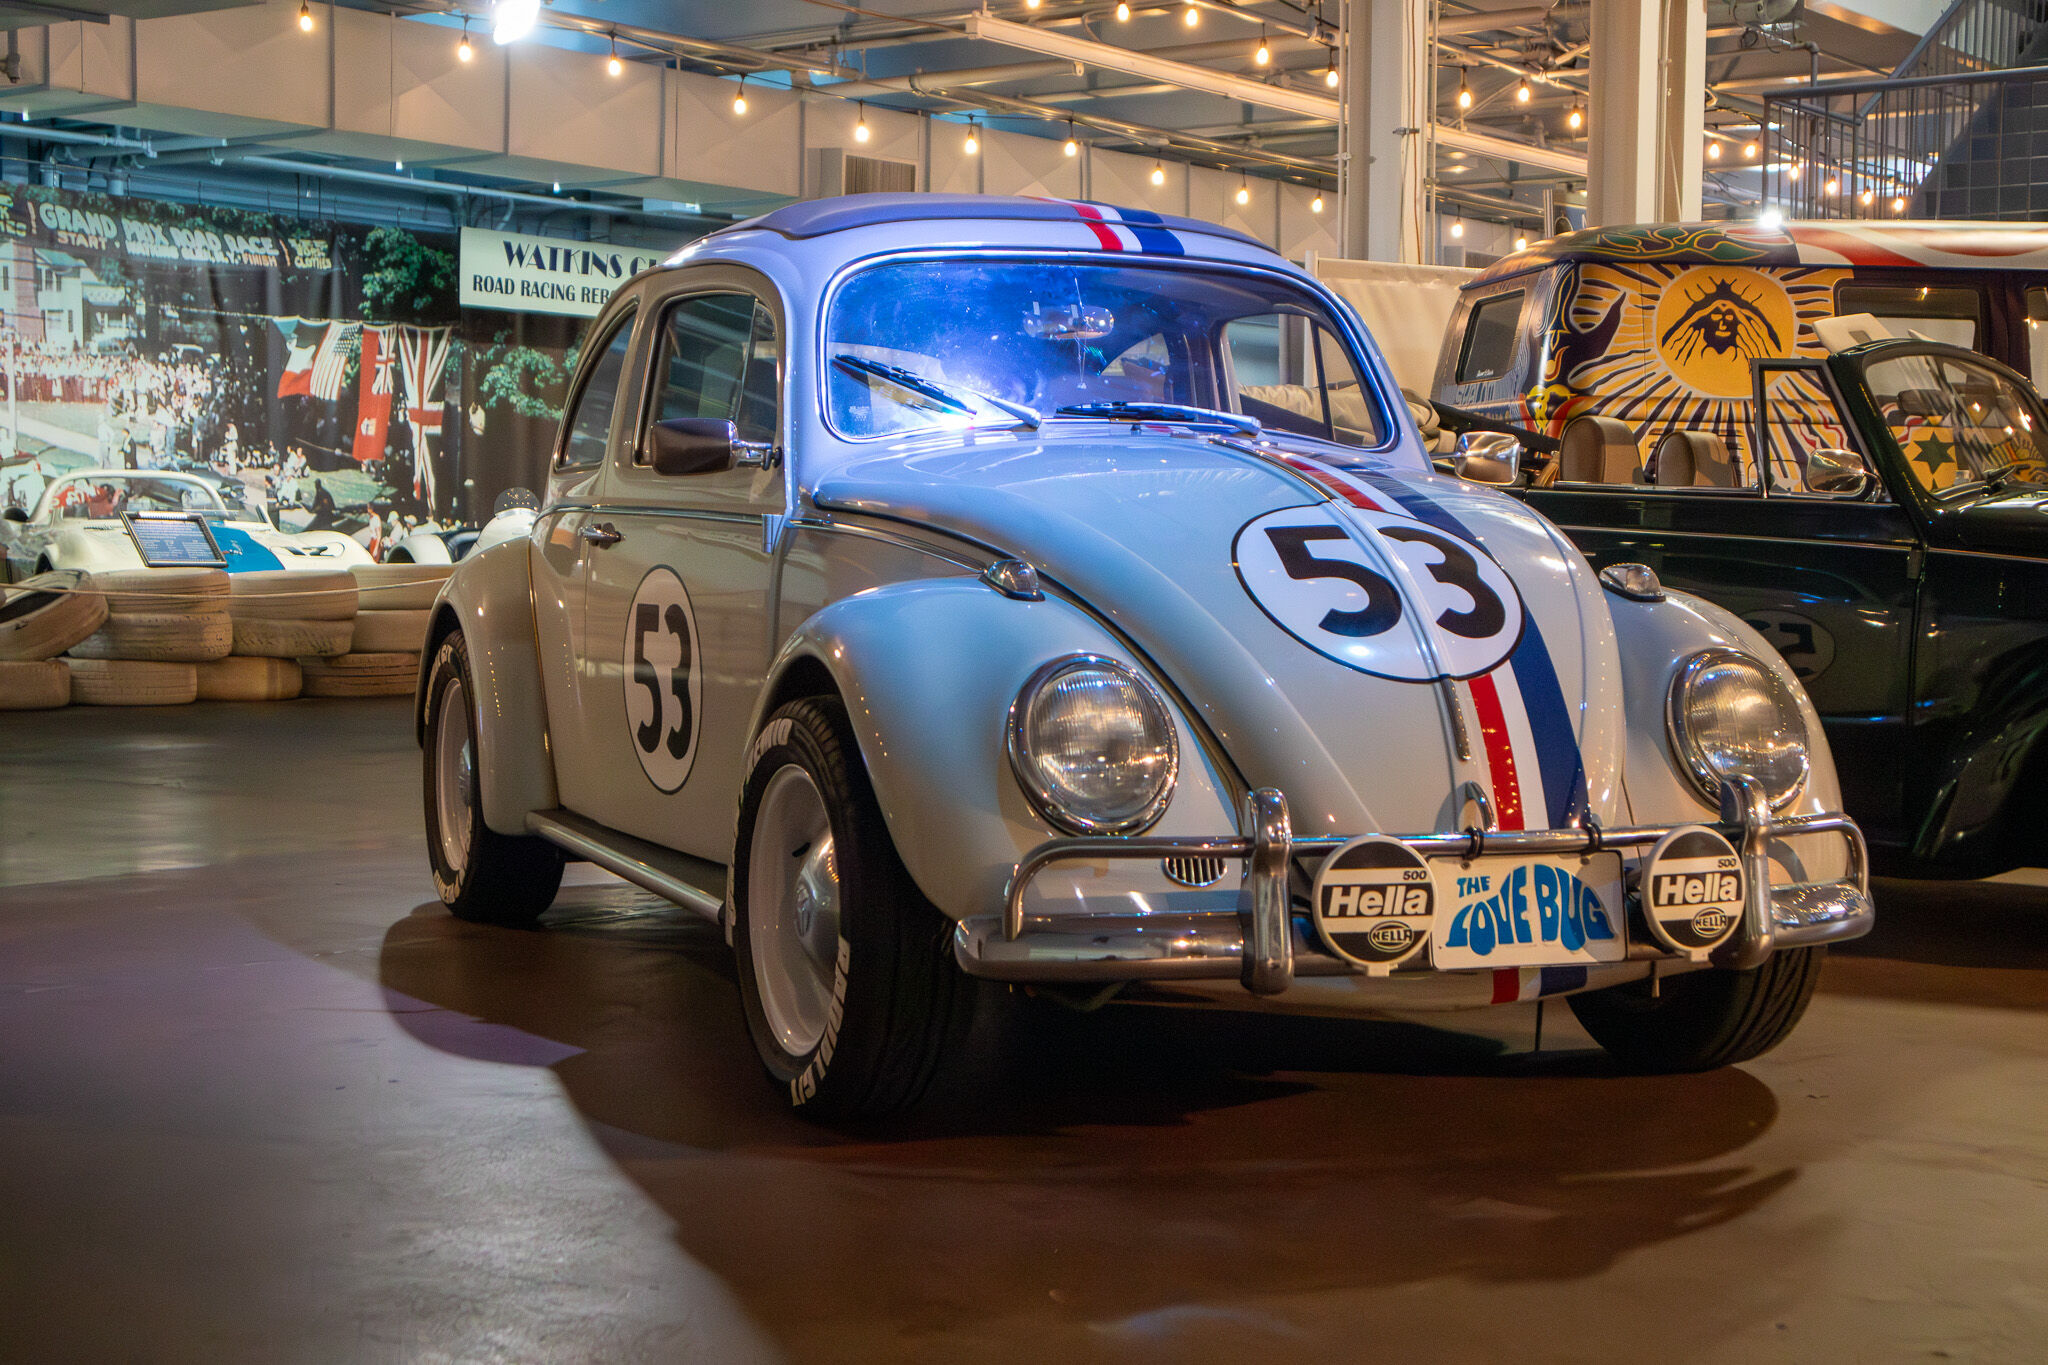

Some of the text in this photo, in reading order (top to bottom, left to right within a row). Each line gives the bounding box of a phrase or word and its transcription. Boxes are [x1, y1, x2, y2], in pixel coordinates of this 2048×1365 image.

[39, 202, 118, 239] GRAND
[223, 233, 280, 256] RACE
[57, 230, 107, 251] START
[242, 251, 278, 267] FINISH
[502, 239, 622, 279] WATKINS
[473, 274, 614, 305] ROAD RACING REB
[1264, 524, 1506, 640] 53
[633, 603, 692, 760] 53
[1402, 870, 1428, 881] 500
[1717, 858, 1737, 868] 500
[1328, 885, 1428, 917] Hella
[1456, 875, 1491, 898] THE
[1658, 872, 1738, 905] Hella
[1445, 864, 1615, 956] LOVE BUG
[1695, 914, 1727, 928] HELLA
[1371, 928, 1413, 943] HELLA
